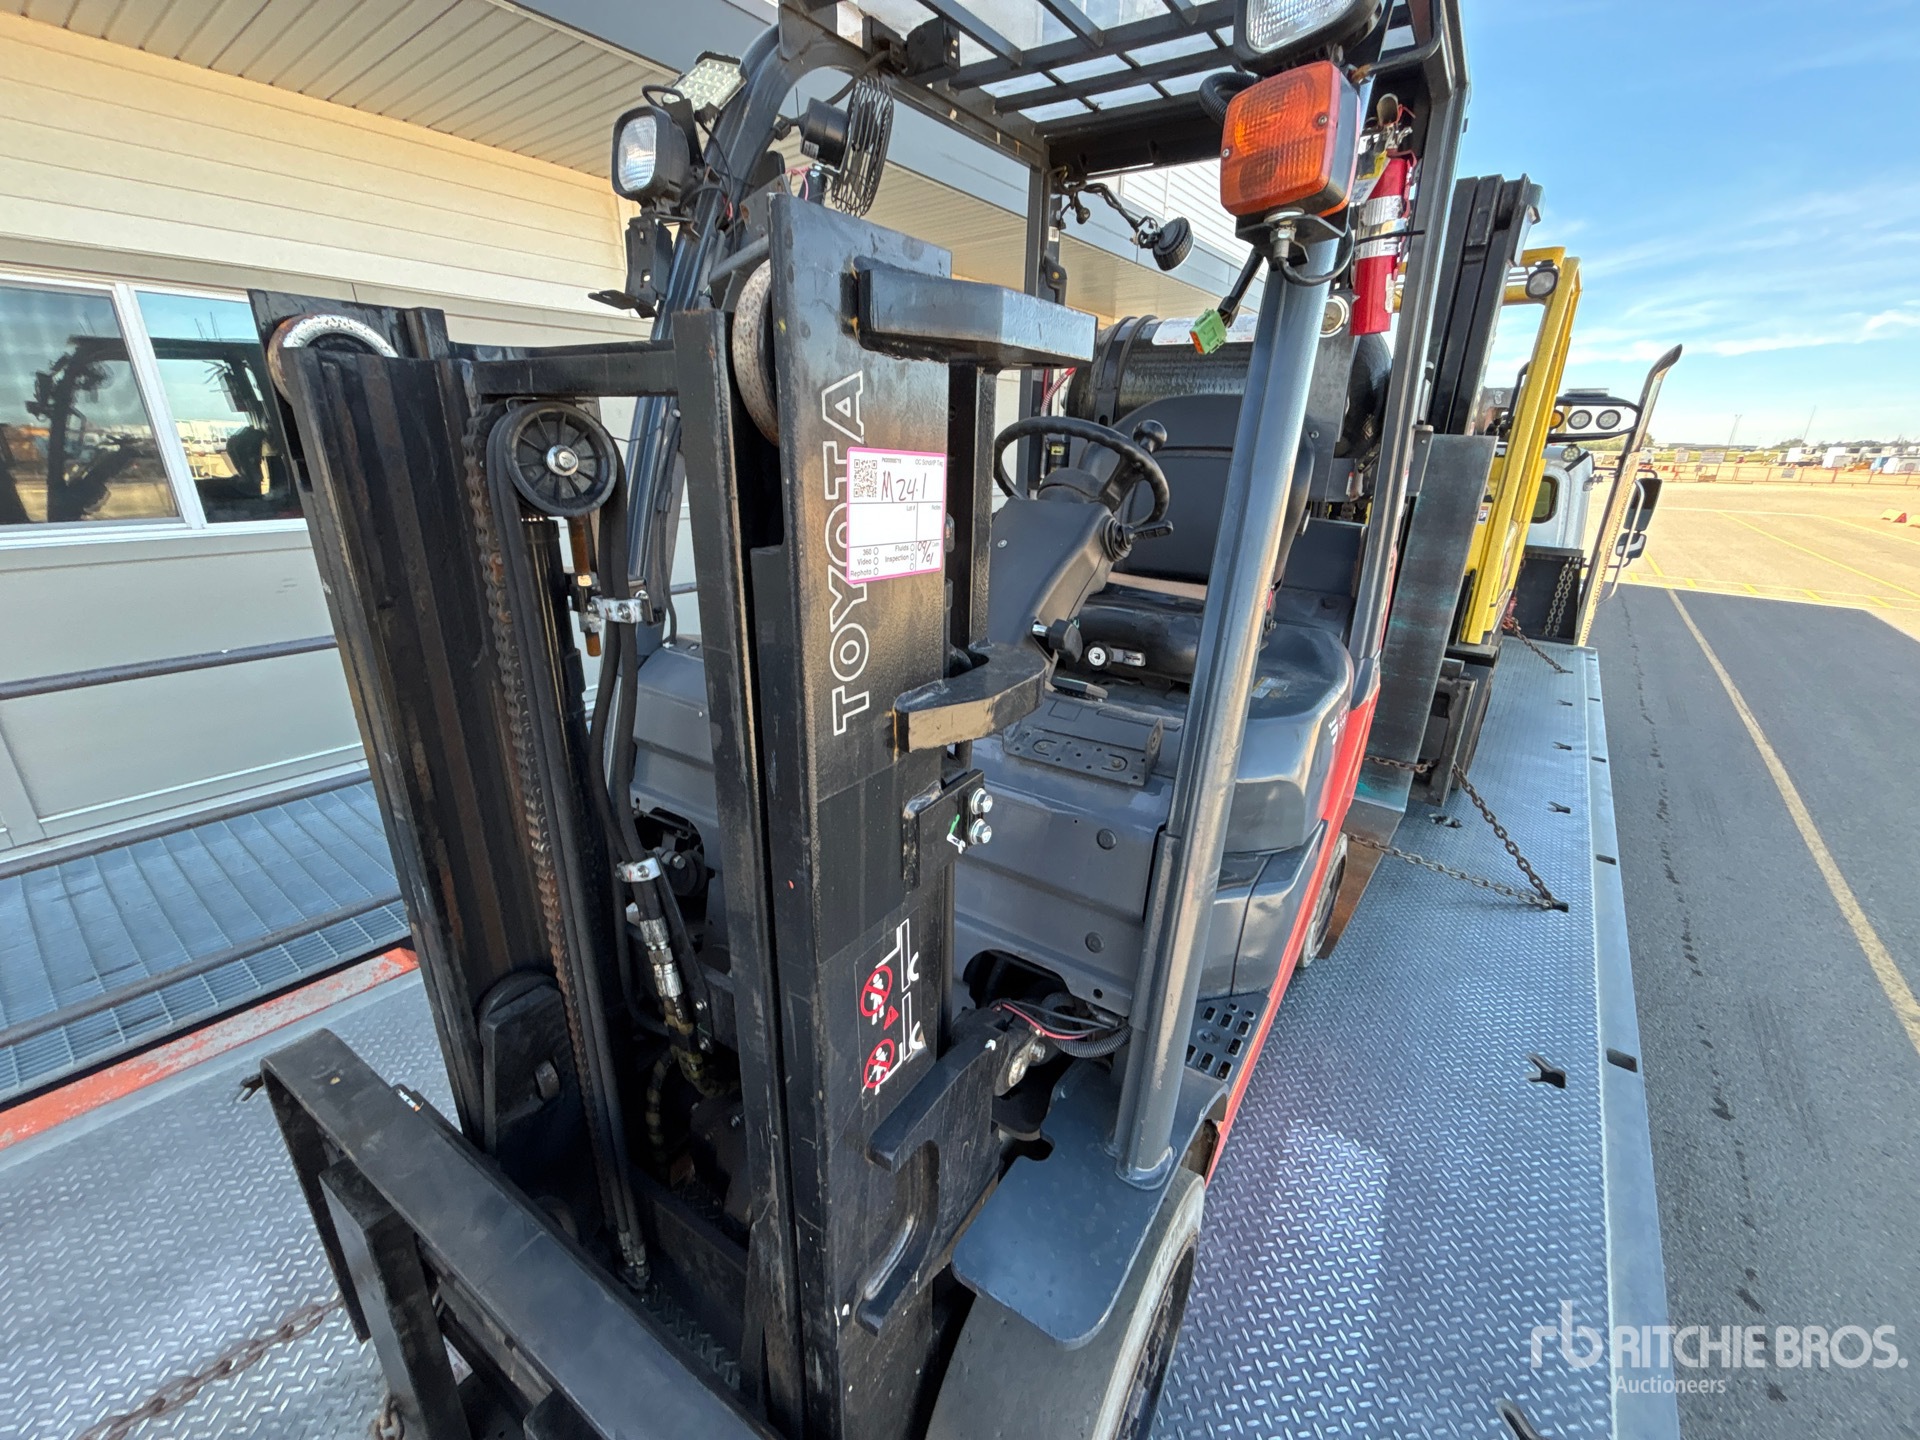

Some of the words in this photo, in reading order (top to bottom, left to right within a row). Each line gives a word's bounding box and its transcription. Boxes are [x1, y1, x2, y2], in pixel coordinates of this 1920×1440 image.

[863, 548, 872, 556] 360
[895, 544, 909, 552] Fluids
[821, 370, 870, 736] TOYOTA
[857, 558, 872, 566] Video
[885, 554, 909, 563] Inspection
[850, 569, 872, 578] Rephoto
